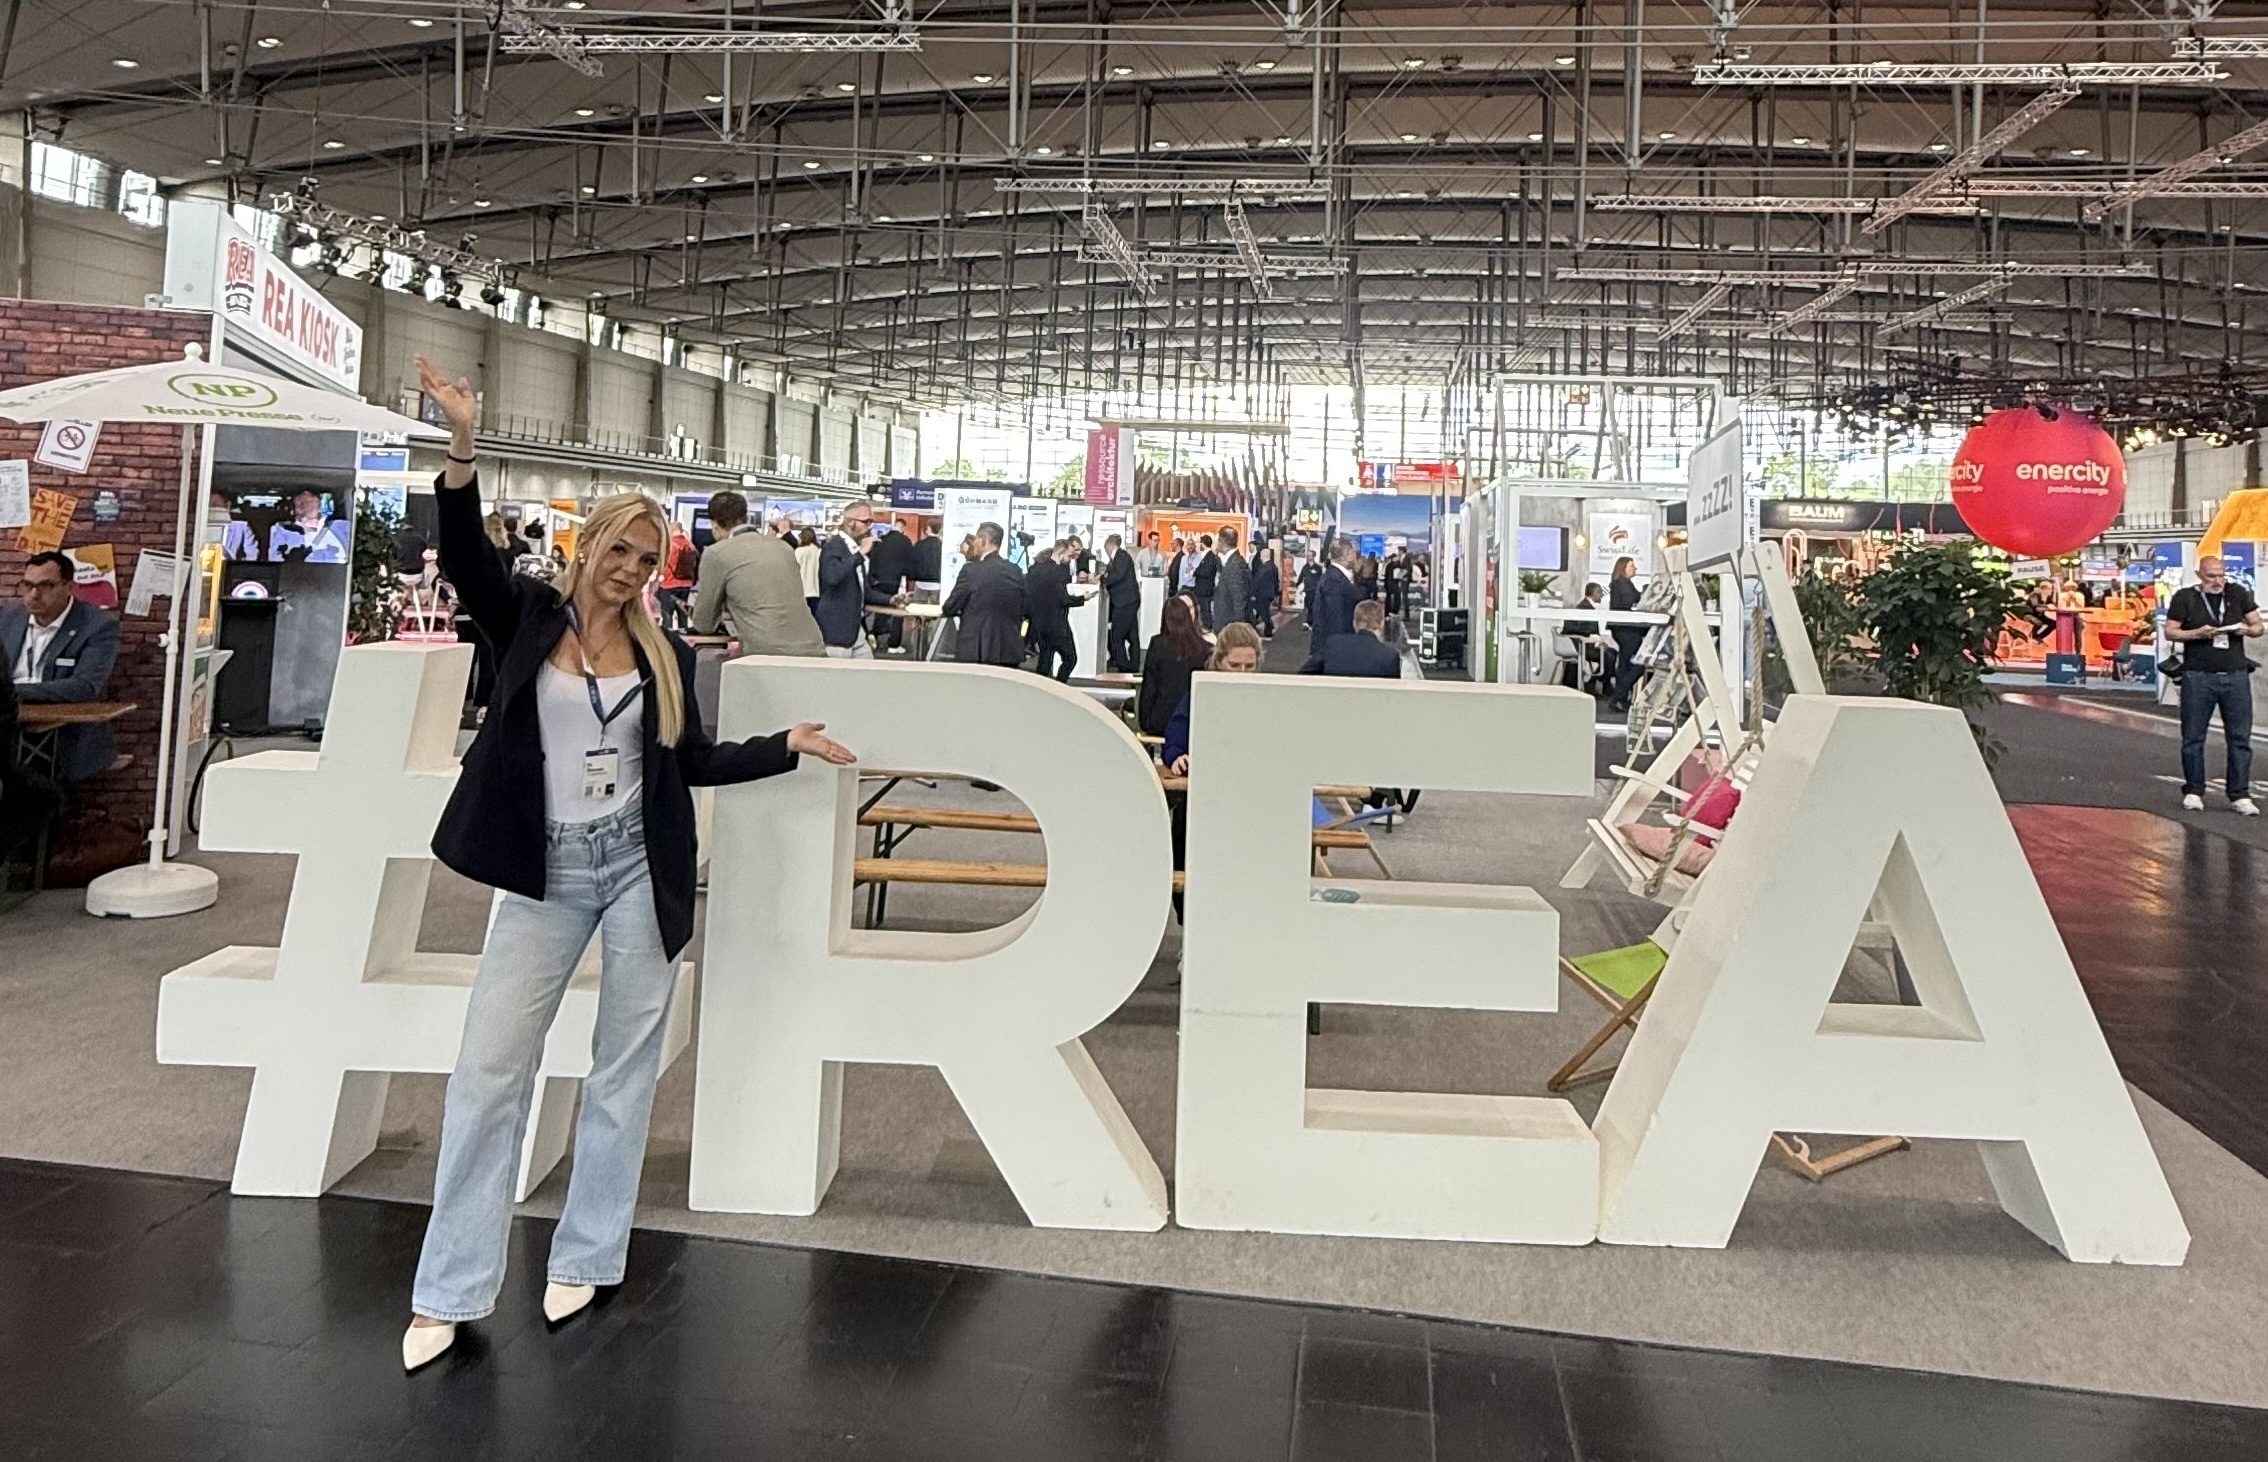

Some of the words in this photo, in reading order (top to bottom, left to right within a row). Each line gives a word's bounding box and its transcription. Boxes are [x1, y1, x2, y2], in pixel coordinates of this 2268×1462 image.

[262, 268, 295, 342] REA
[299, 298, 339, 369] KIOSK
[190, 382, 257, 399] NP
[143, 404, 214, 417] Neue
[216, 408, 304, 422] Presse
[1105, 436, 1116, 501] architektur
[2016, 460, 2110, 486] enercity
[35, 490, 76, 511] SAVE
[32, 505, 70, 529] THE
